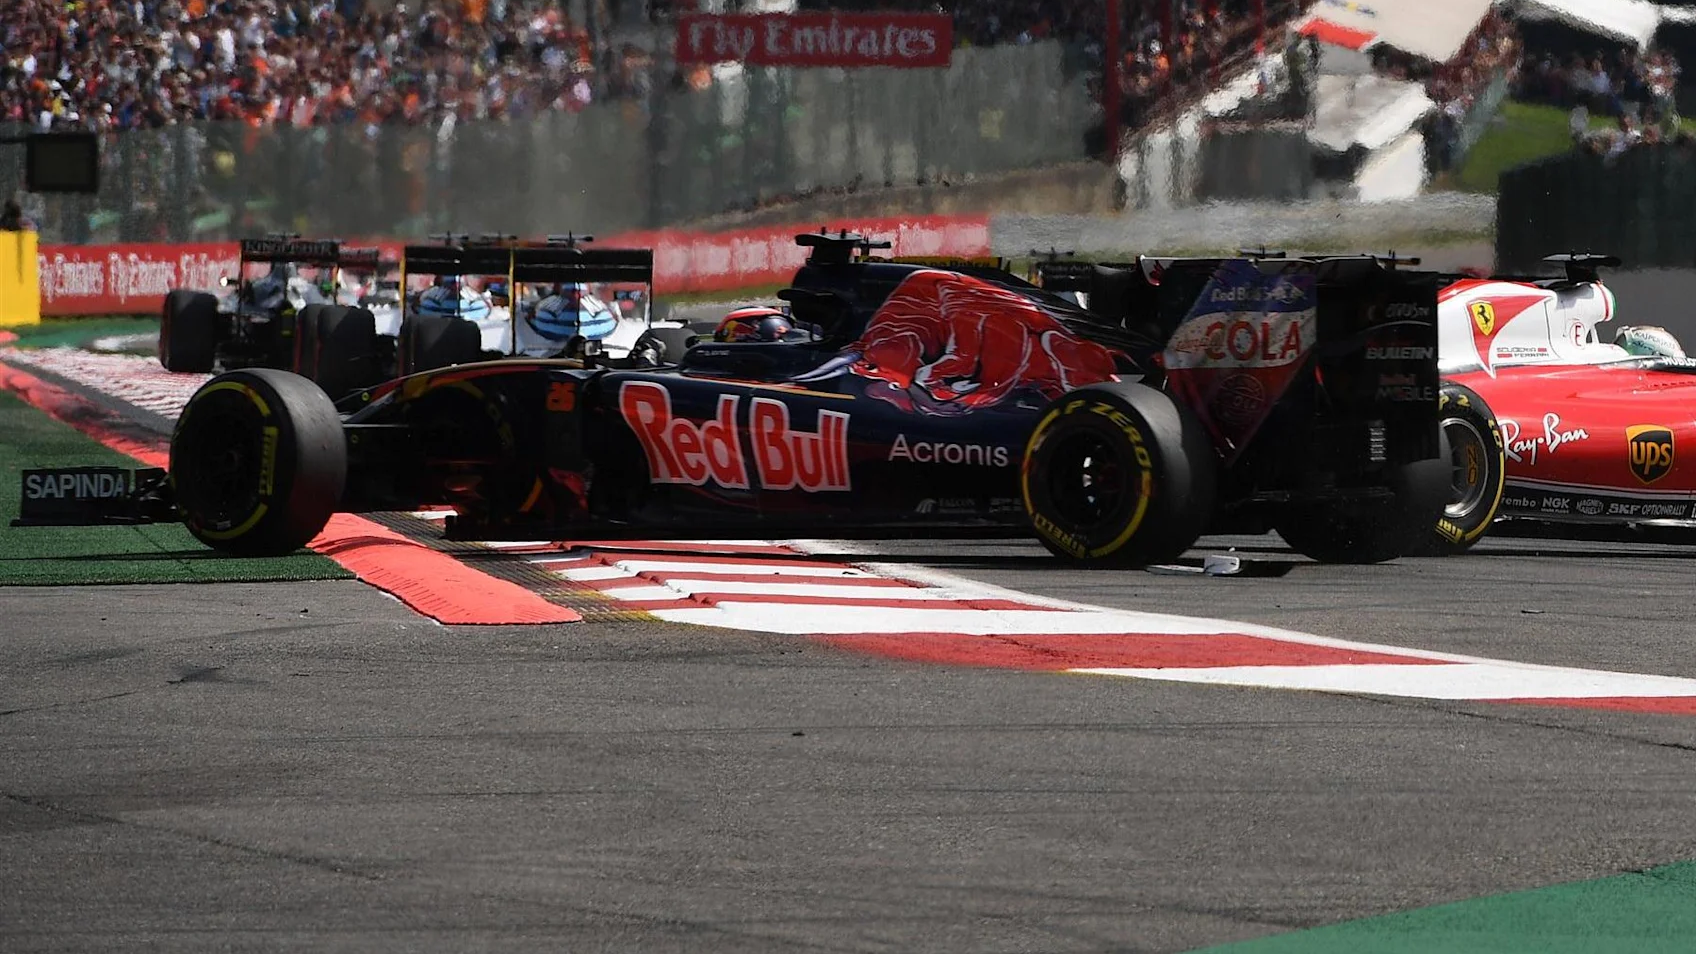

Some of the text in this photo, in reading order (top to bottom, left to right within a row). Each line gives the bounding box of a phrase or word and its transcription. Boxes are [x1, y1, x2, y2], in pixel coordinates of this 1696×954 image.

[689, 16, 936, 57] Fly Emirates
[55, 252, 103, 296] Emirates
[109, 251, 177, 304] Fly Emirates
[1205, 320, 1300, 361] COLA
[1364, 346, 1434, 360] BULLETIN
[619, 379, 750, 489] Red
[748, 395, 851, 492] Bull
[888, 434, 1009, 468] Acronis
[1089, 401, 1153, 469] ZERO
[1631, 440, 1672, 476] ups
[26, 473, 125, 499] SAPINDA
[1501, 497, 1570, 509] rembo NGK
[1608, 503, 1641, 515] SKF
